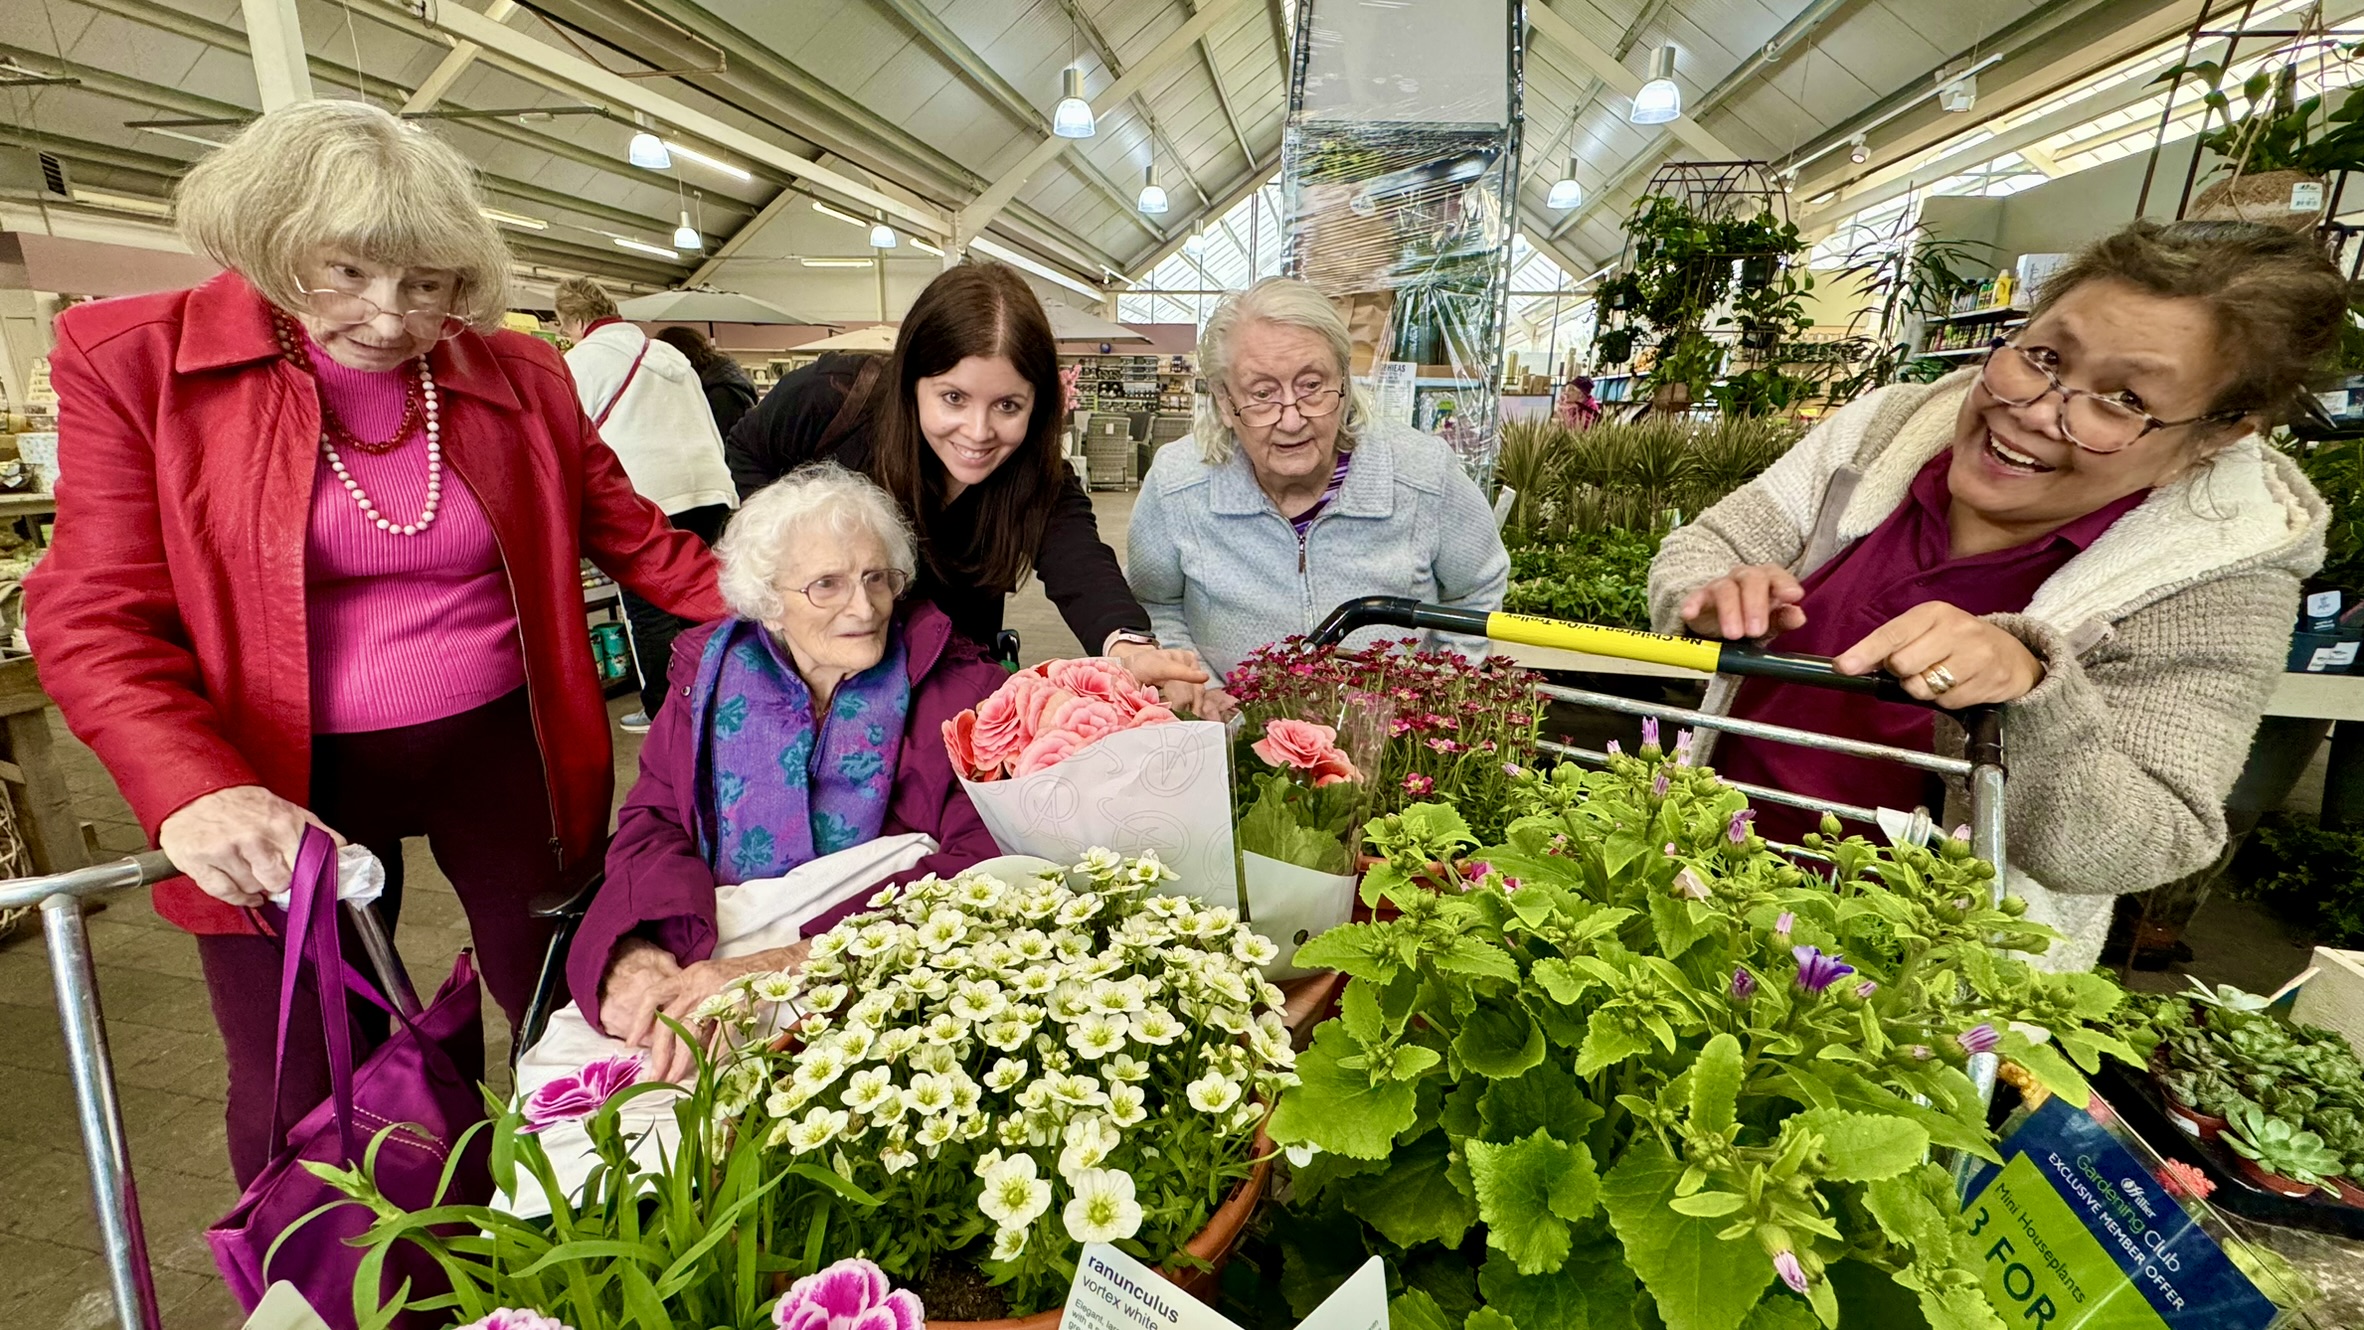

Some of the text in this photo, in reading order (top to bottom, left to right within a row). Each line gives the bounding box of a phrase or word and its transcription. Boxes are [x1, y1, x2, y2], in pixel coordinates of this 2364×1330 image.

[1967, 1206, 2056, 1330] 3 FOR
[1995, 1182, 2086, 1304] Mini Houseplants
[2048, 1152, 2185, 1312] EXCLUSIVE MEMBER OFFER
[2077, 1154, 2181, 1272] Gardening Club
[1072, 1310, 1087, 1325] with
[1083, 1275, 1158, 1330] vortex white
[1088, 1256, 1179, 1323] ranunculus
